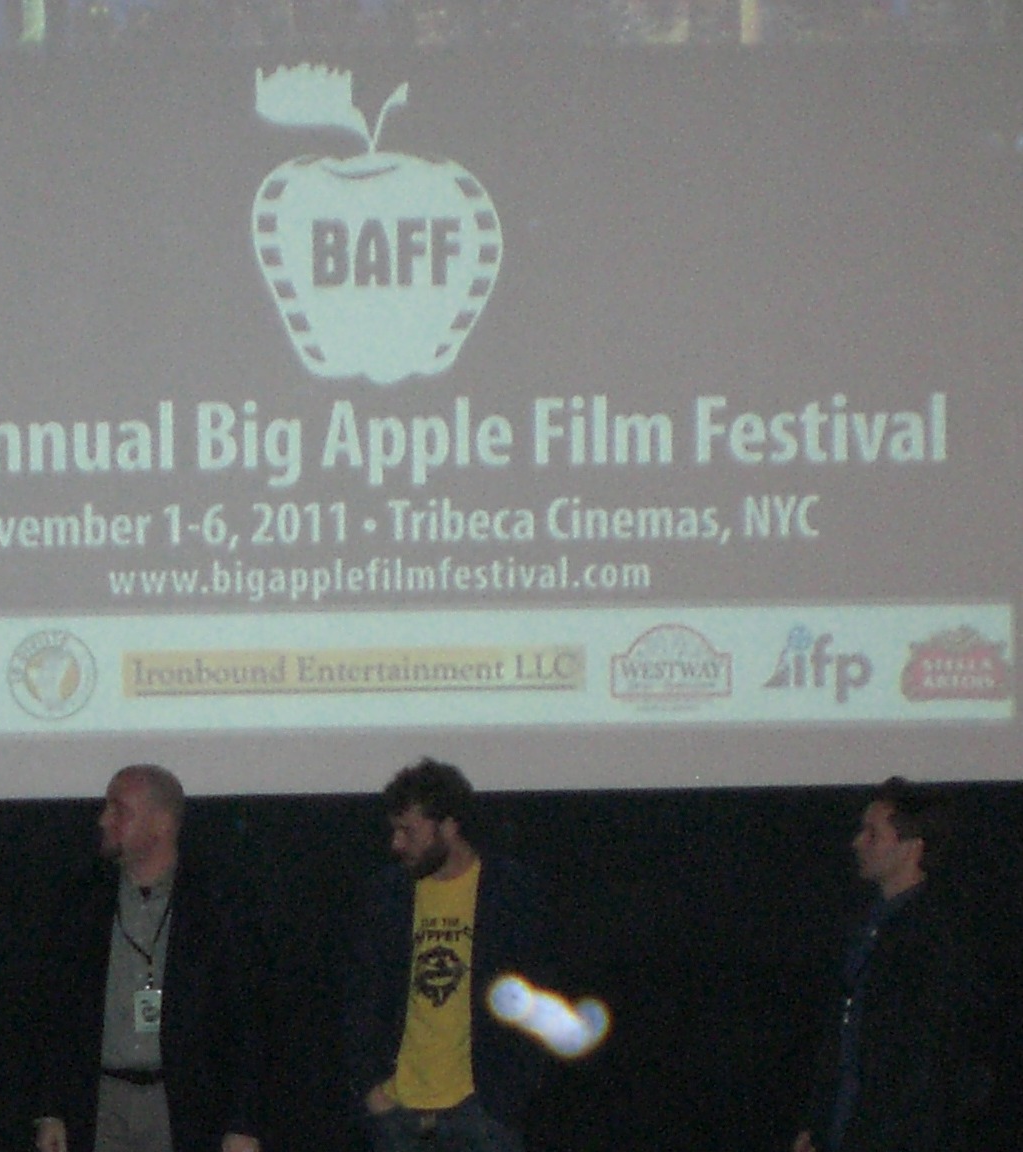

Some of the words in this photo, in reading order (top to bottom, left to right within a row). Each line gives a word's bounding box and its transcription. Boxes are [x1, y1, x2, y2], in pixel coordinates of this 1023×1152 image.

[311, 217, 461, 287] BAFF
[196, 400, 302, 488] Big
[322, 396, 513, 486] Apple
[534, 395, 674, 466] Film
[696, 393, 947, 464] Festival
[162, 503, 238, 549] 1-6,
[251, 501, 348, 545] 2011
[387, 498, 534, 543] Tribeca
[546, 496, 731, 545] Cinemas,
[744, 494, 821, 539] NYC
[109, 556, 652, 600] www.bigapplefilmfestival.com
[133, 655, 286, 687] Ironbound
[297, 655, 505, 684] Entertainment
[619, 660, 722, 681] WESTWAY
